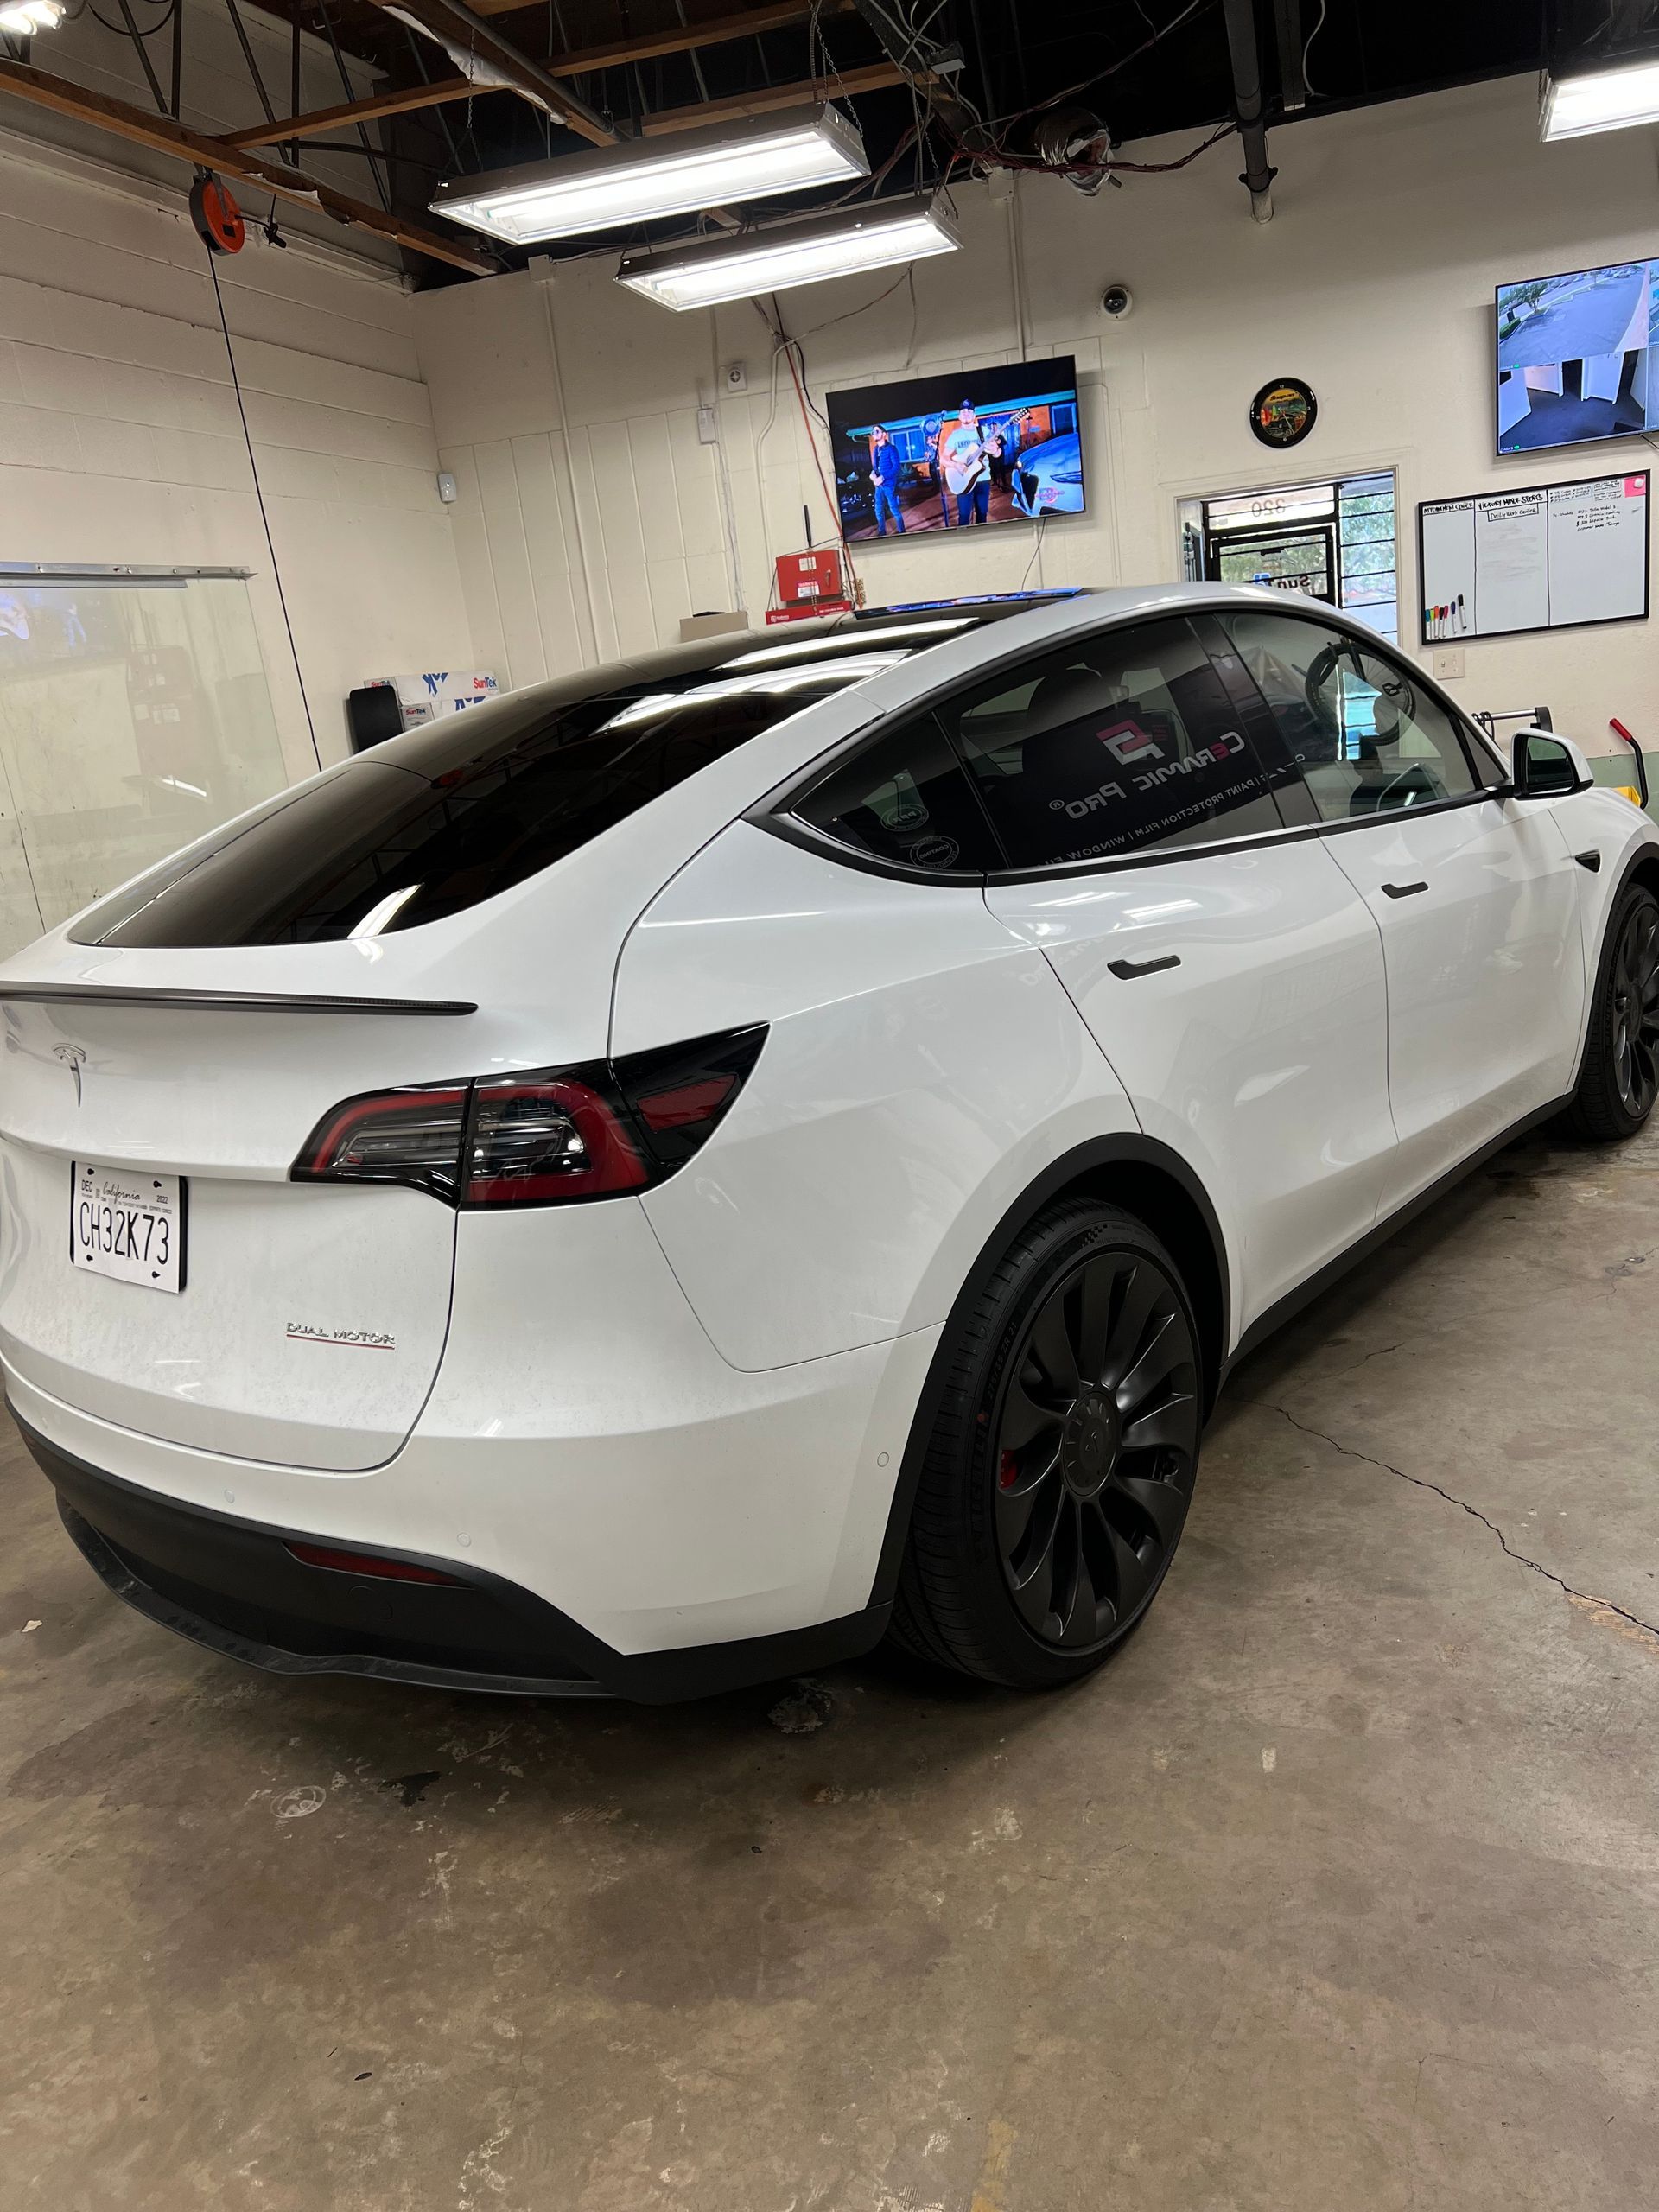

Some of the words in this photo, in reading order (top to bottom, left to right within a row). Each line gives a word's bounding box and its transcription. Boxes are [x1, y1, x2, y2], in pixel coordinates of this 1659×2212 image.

[473, 677, 497, 690] SunTek
[81, 1179, 92, 1192] DEC
[103, 1181, 141, 1205] California
[156, 1195, 168, 1205] 2022
[79, 1202, 169, 1265] CH32K73
[287, 1322, 329, 1338] DUAL
[334, 1329, 396, 1344] MOTOR
